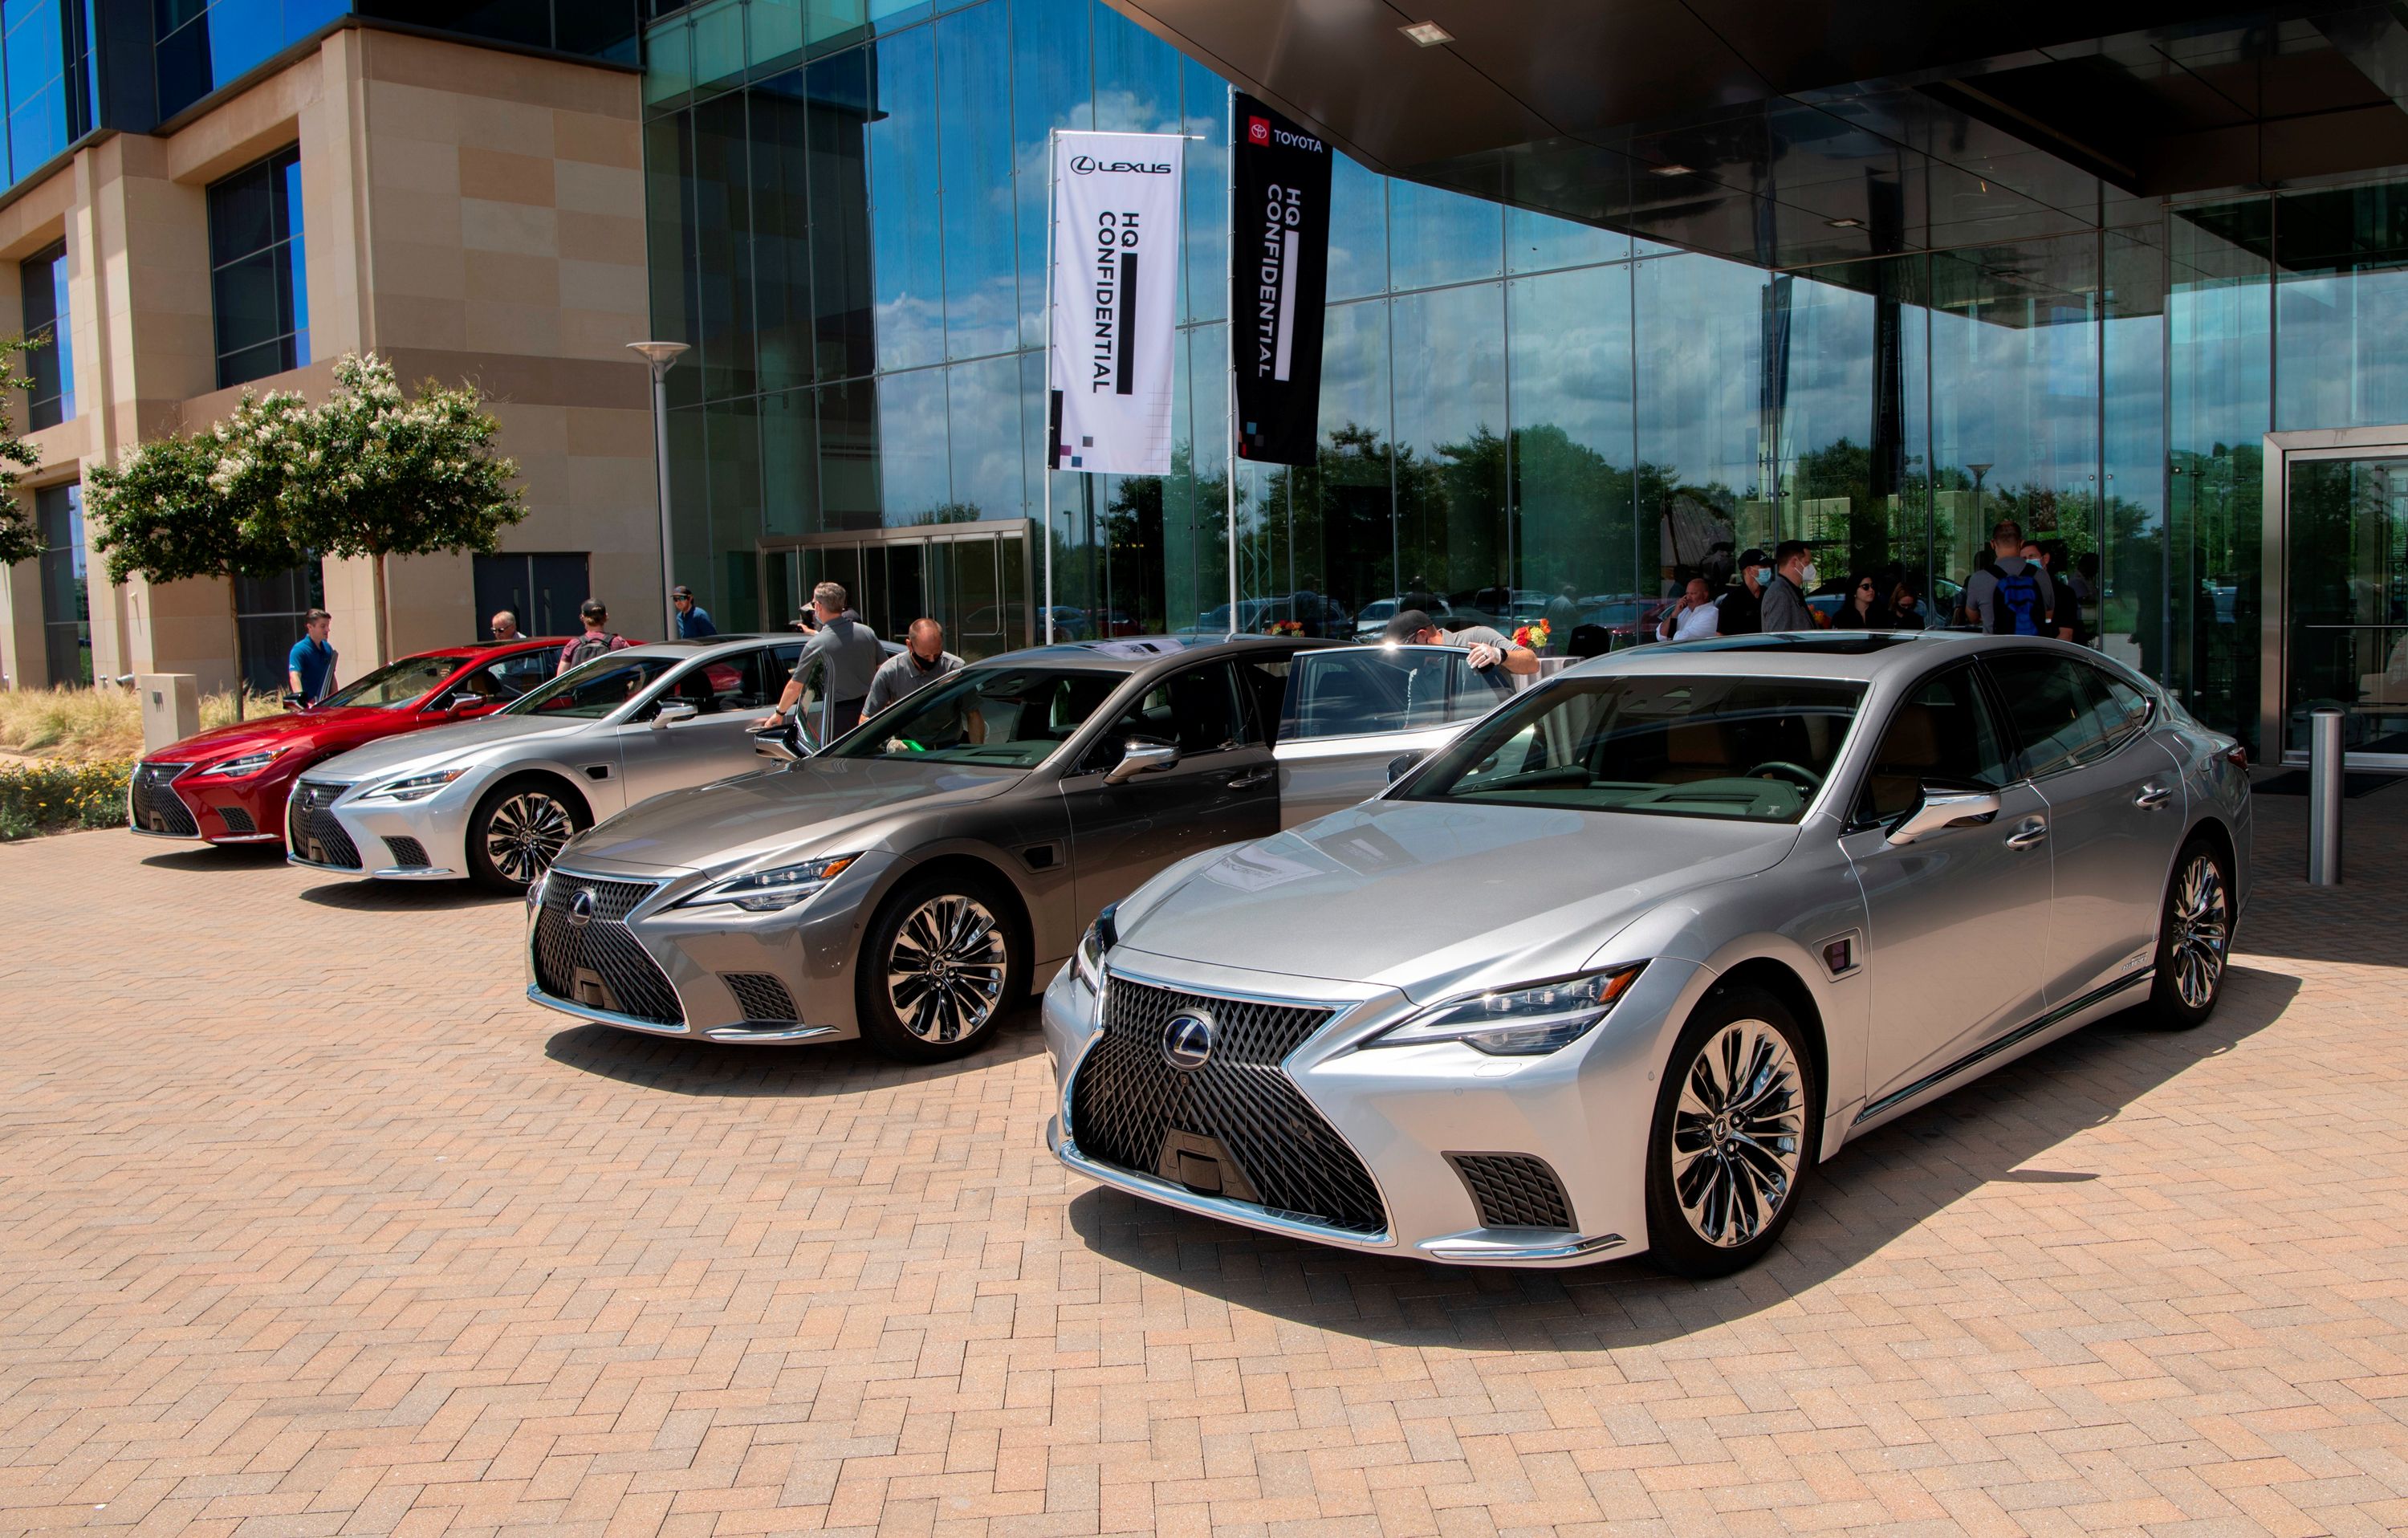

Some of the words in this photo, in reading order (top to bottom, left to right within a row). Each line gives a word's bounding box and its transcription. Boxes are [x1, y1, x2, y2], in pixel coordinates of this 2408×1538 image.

[1274, 128, 1323, 153] TOYOTA
[1098, 161, 1172, 174] LEXUS
[1284, 187, 1301, 226] HQ
[1121, 212, 1140, 248] HQ
[1259, 184, 1283, 377] CONFIDENTIAL
[1092, 211, 1117, 394] CONFIDENTIAL
